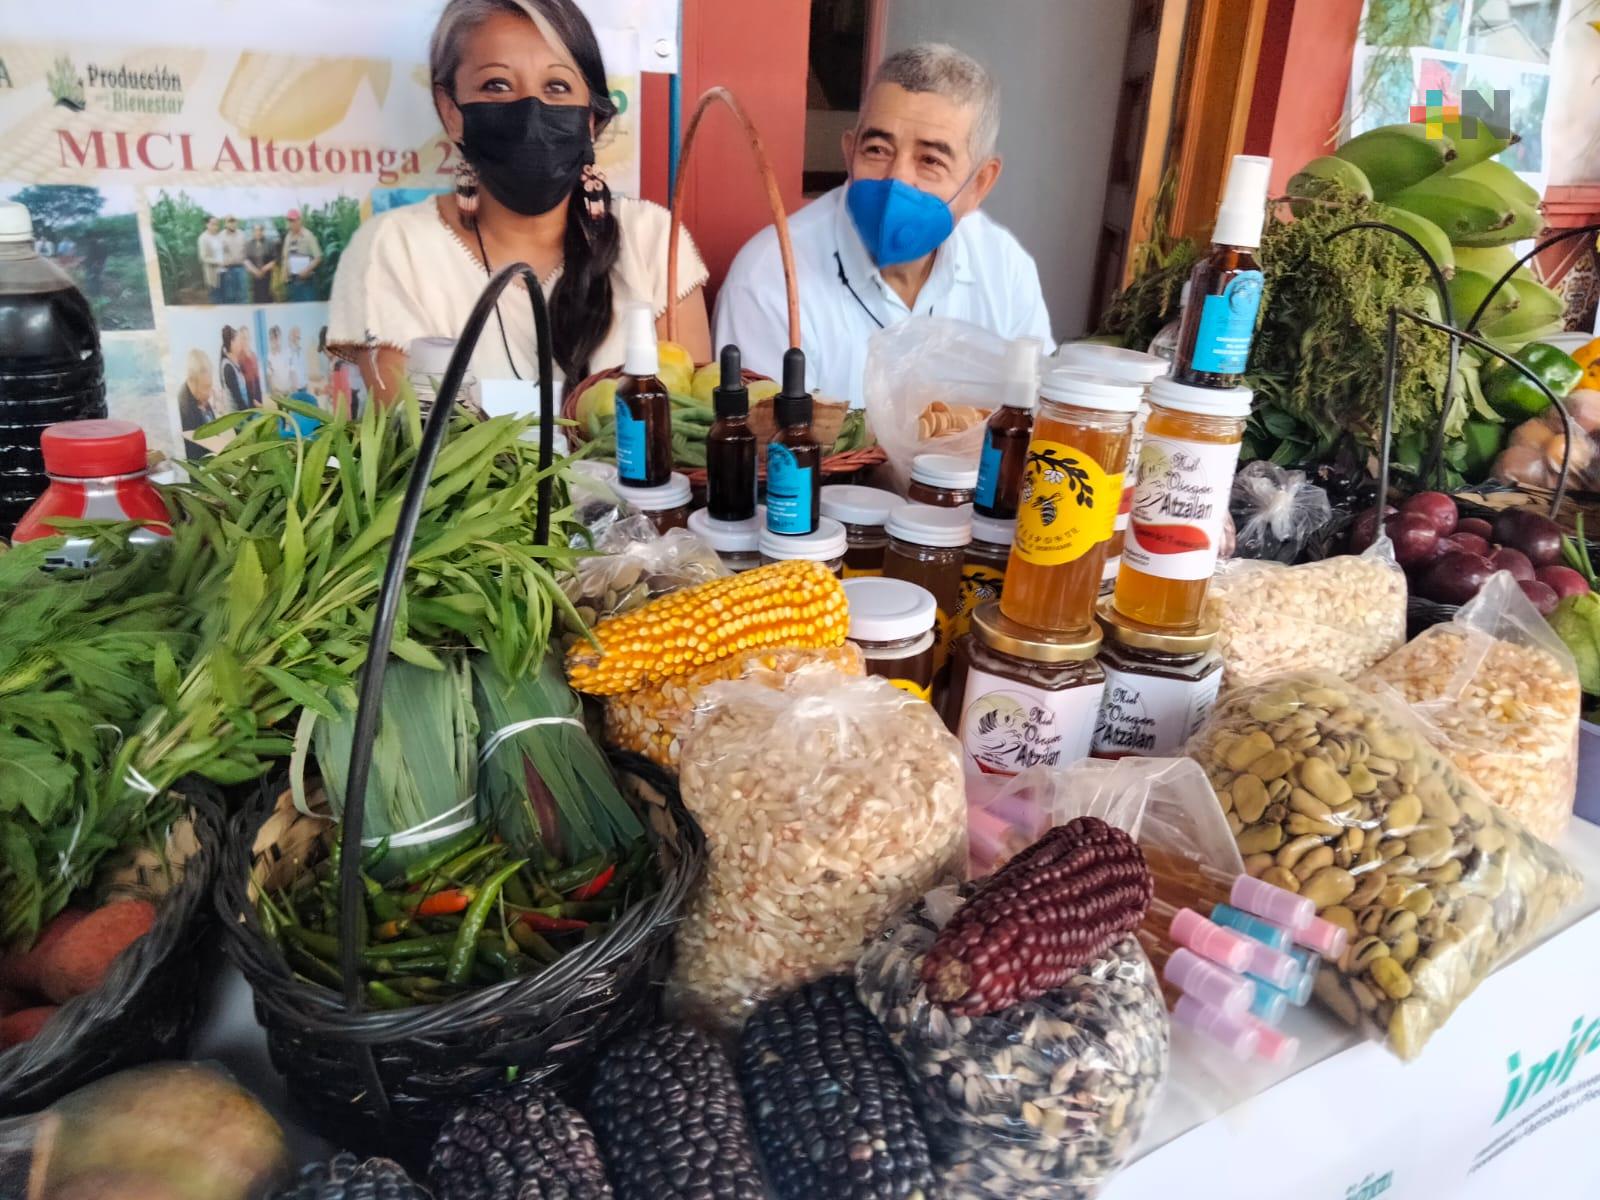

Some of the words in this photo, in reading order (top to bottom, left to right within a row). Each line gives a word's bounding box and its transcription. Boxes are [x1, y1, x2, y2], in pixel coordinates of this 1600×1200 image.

[87, 64, 183, 92] Producción
[113, 91, 184, 114] Bienestar
[55, 129, 198, 172] MICI
[212, 135, 421, 185] Altotonga
[1159, 493, 1213, 520] Atzalan
